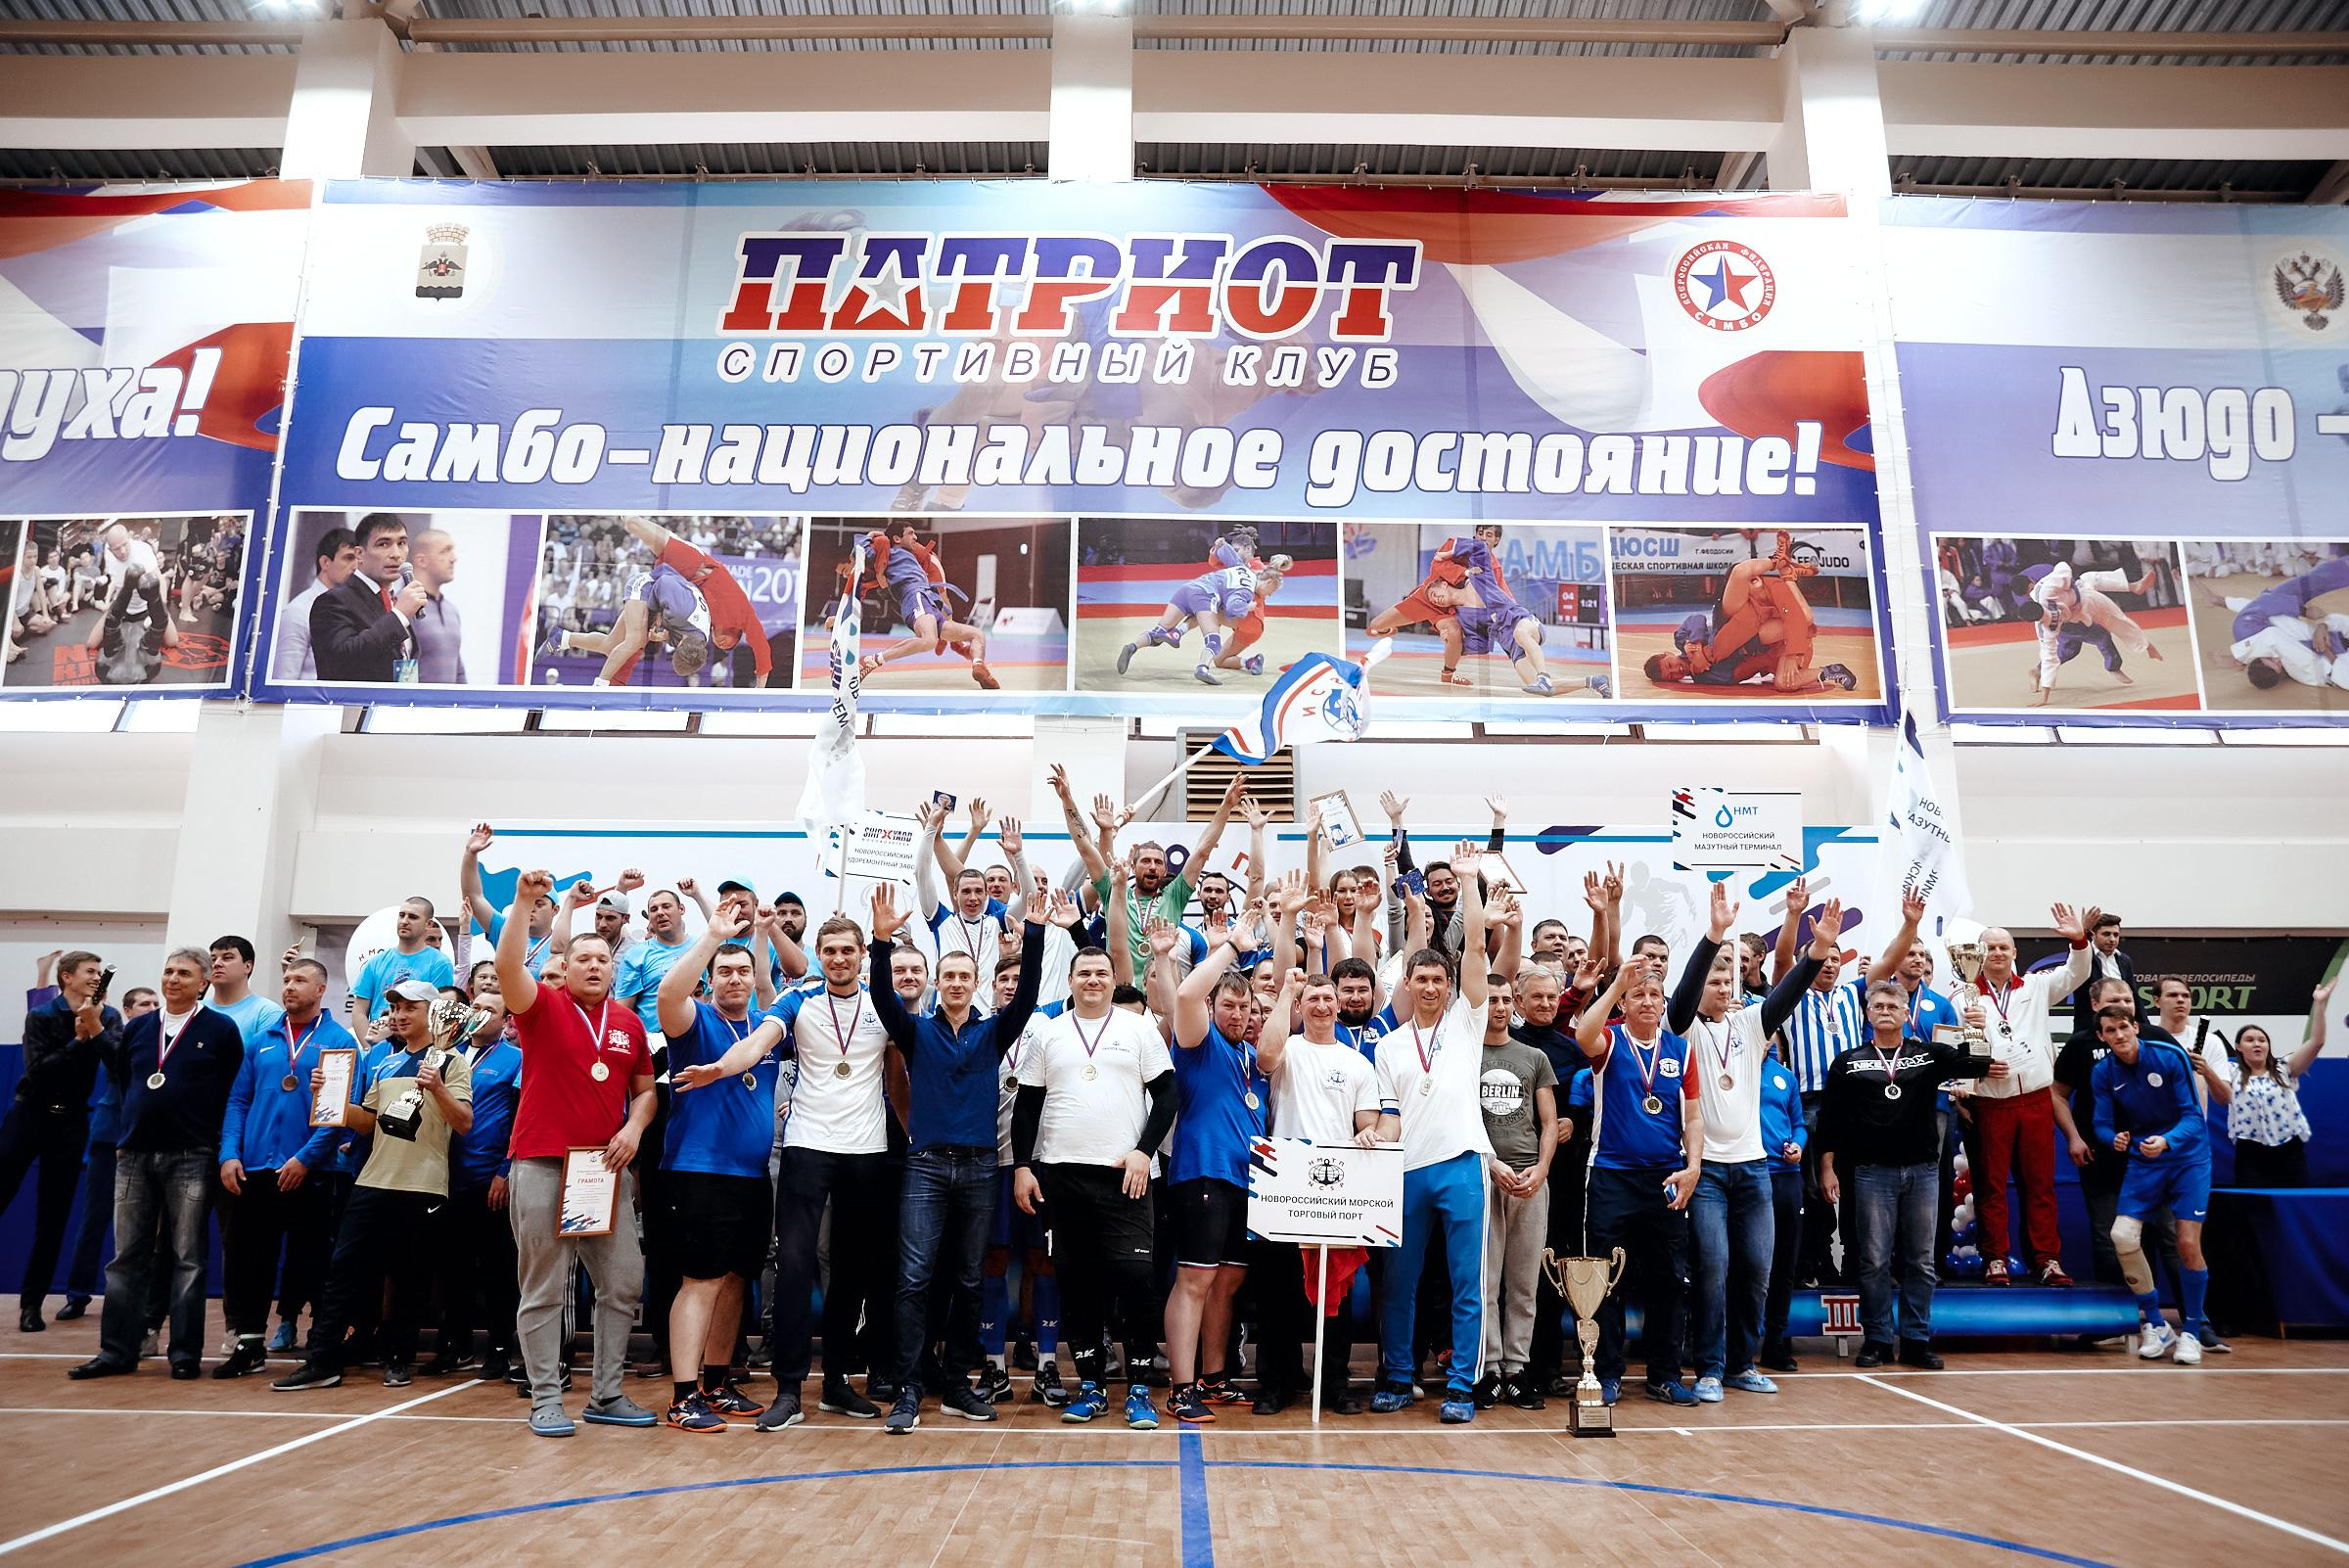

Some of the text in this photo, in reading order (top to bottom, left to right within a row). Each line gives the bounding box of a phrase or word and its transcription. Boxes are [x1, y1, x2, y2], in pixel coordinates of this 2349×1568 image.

[717, 235, 1421, 338] ПАТРИОТ
[1694, 311, 1762, 331] САМБО
[722, 341, 1400, 383] СПОРТИВНЫЙ КЛУБ
[2051, 365, 2296, 483] Дзюдо
[1305, 419, 1824, 509] достояние!
[1647, 562, 1704, 571] СПОРТИВНАЯ
[1733, 806, 1759, 815] НМТ
[1908, 808, 1951, 843] АЗУТН
[854, 848, 913, 859] НОВОРОССИЙСКИЙ
[847, 856, 898, 868] УДОРЕМОНТНЫЙ
[1481, 1084, 1520, 1098] BERLIN
[1308, 1180, 1345, 1191] NCSP
[1261, 1194, 1395, 1208] НОВОРОССИЙСКИЙ МОРСКОЙ
[1288, 1209, 1363, 1221] ТОРГОВЫЙ ПОРТ
